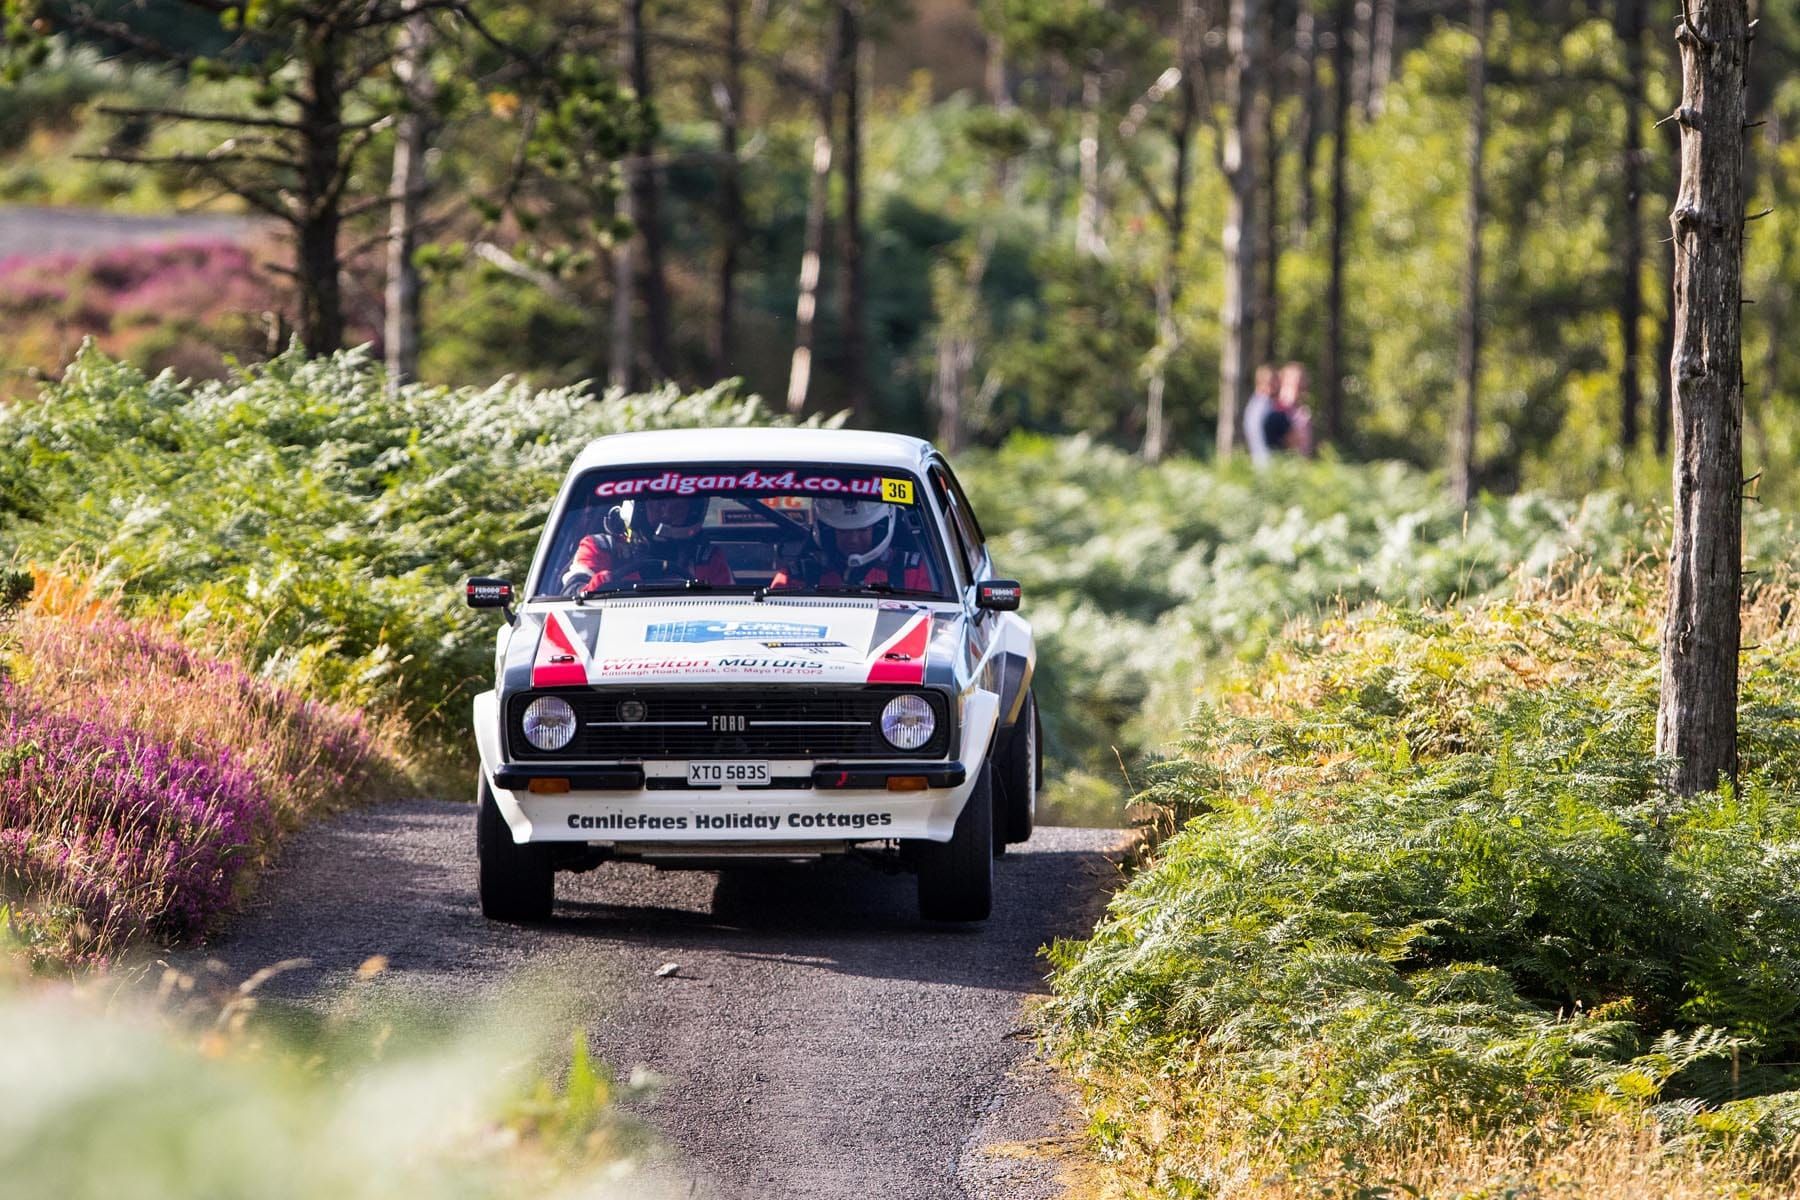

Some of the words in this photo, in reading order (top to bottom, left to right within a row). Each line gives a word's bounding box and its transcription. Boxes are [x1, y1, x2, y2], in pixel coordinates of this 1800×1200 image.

[595, 470, 883, 497] cardigan4x4.co.uk
[888, 481, 907, 499] 36
[712, 715, 745, 732] FORD
[692, 765, 722, 780] XTO
[726, 765, 767, 780] 583S
[567, 813, 688, 829] Canllefaes
[695, 812, 781, 830] Holiday
[787, 812, 892, 829] Cottages
